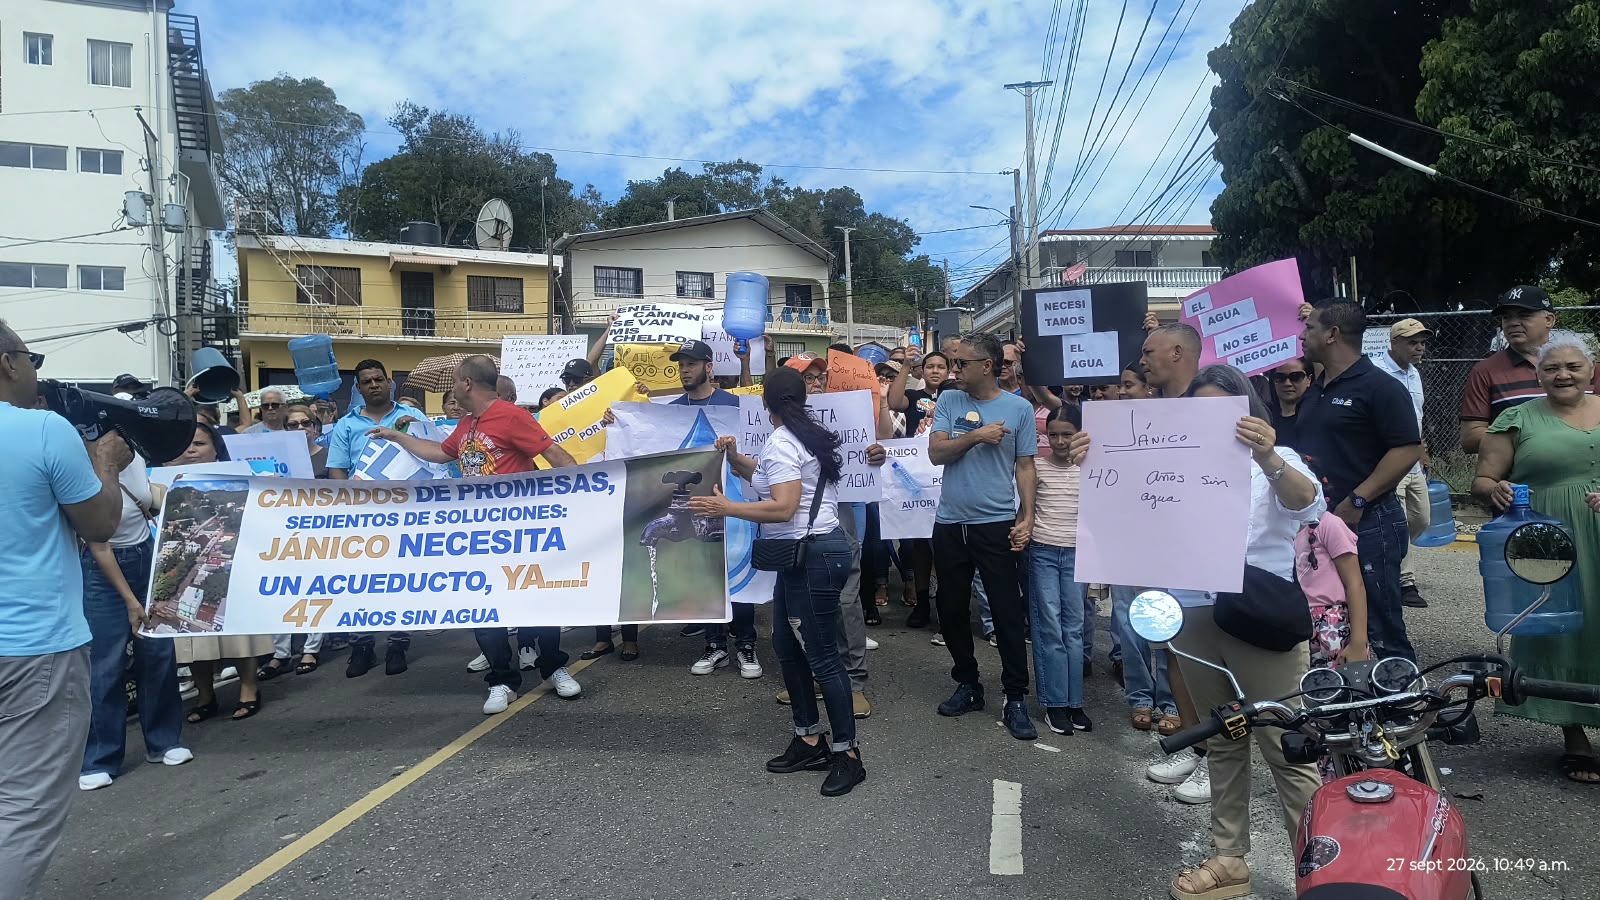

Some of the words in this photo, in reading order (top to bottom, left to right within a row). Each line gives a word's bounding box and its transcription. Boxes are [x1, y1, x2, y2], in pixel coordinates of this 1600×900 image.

[1043, 300, 1086, 311] NECESI
[1191, 302, 1206, 313] EL
[633, 311, 700, 322] CAMIÓN
[1045, 316, 1085, 327] TAMOS
[1207, 307, 1241, 326] AGUA
[609, 327, 640, 335] MIS
[612, 334, 697, 343] CHELITO
[1070, 344, 1084, 352] EL
[1222, 339, 1240, 352] NO
[1242, 332, 1259, 345] SE
[1234, 341, 1289, 366] NEGOCIA
[1070, 358, 1104, 369] AGUA
[747, 410, 762, 426] LA
[579, 424, 600, 440] POR
[1088, 468, 1119, 488] 40
[257, 487, 409, 508] CANSADOS
[415, 484, 451, 503] DE
[458, 471, 616, 502] PROMESAS,
[285, 513, 399, 529] SEDIENTOS
[403, 511, 431, 527] DE
[434, 504, 568, 525] SOLUCIONES:
[258, 532, 390, 562] JÁNICO
[398, 527, 567, 558] NECESITA
[258, 576, 301, 596] UN
[306, 571, 493, 596] ACUEDUCTO,
[282, 598, 333, 628] 47
[337, 608, 396, 627] AÑOS
[401, 610, 437, 625] SIN
[440, 608, 499, 624] AGUA
